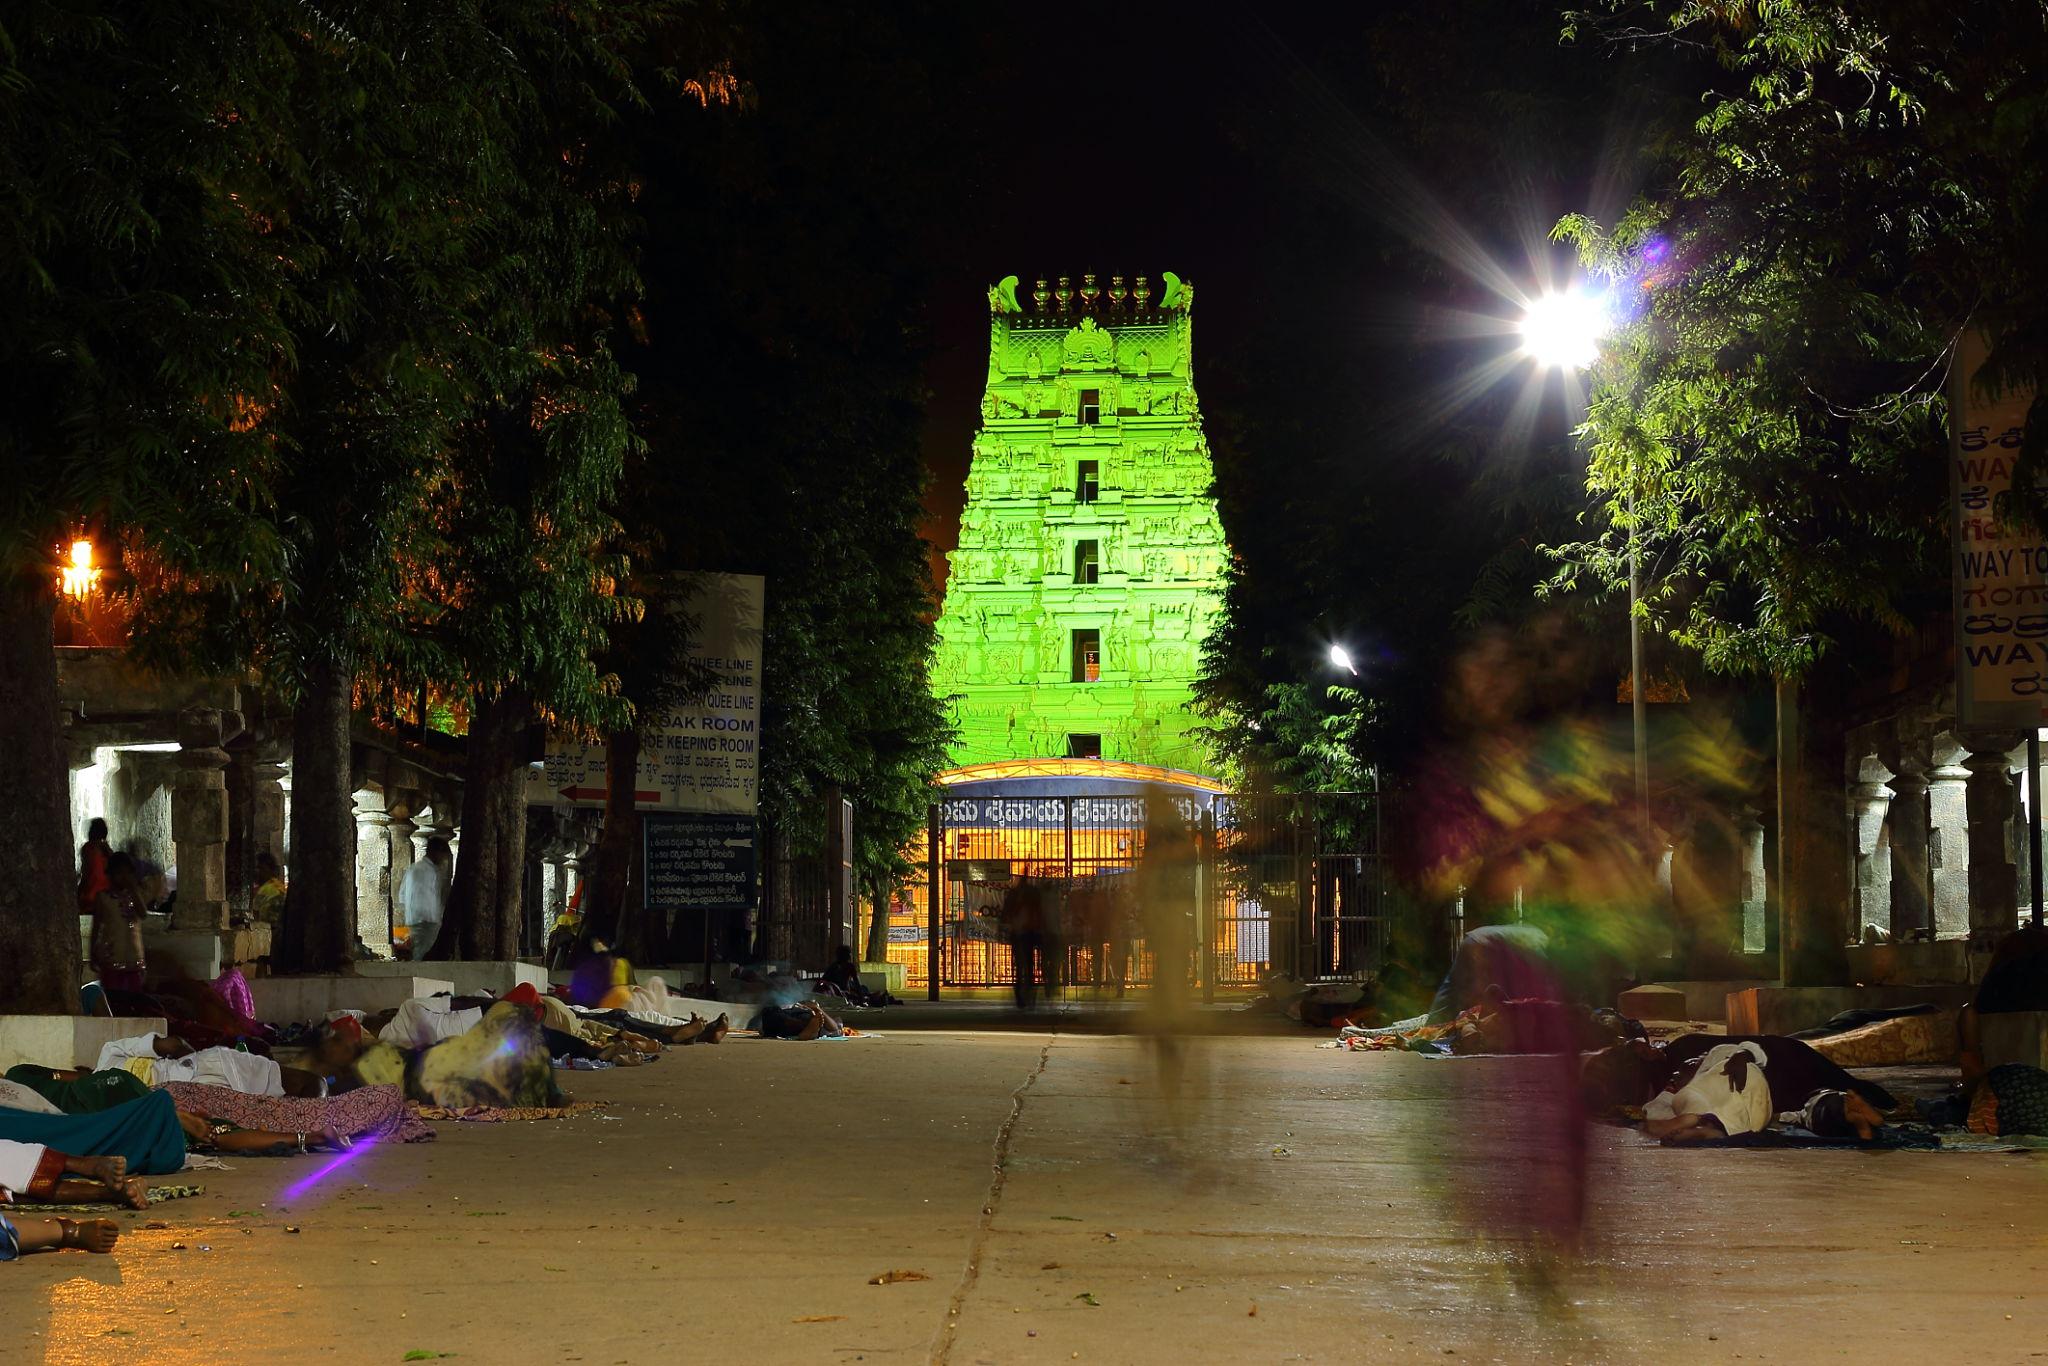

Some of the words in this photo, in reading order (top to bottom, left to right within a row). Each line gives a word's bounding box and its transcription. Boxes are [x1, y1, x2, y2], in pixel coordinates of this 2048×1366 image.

[1961, 548, 2014, 579] WAY
[2020, 545, 2048, 576] TO
[726, 658, 753, 671] LINE
[707, 694, 732, 709] QUEE
[734, 695, 754, 710] LINE
[702, 716, 754, 732] ROOM
[666, 735, 717, 751] KEEPING
[720, 738, 754, 753] ROOM
